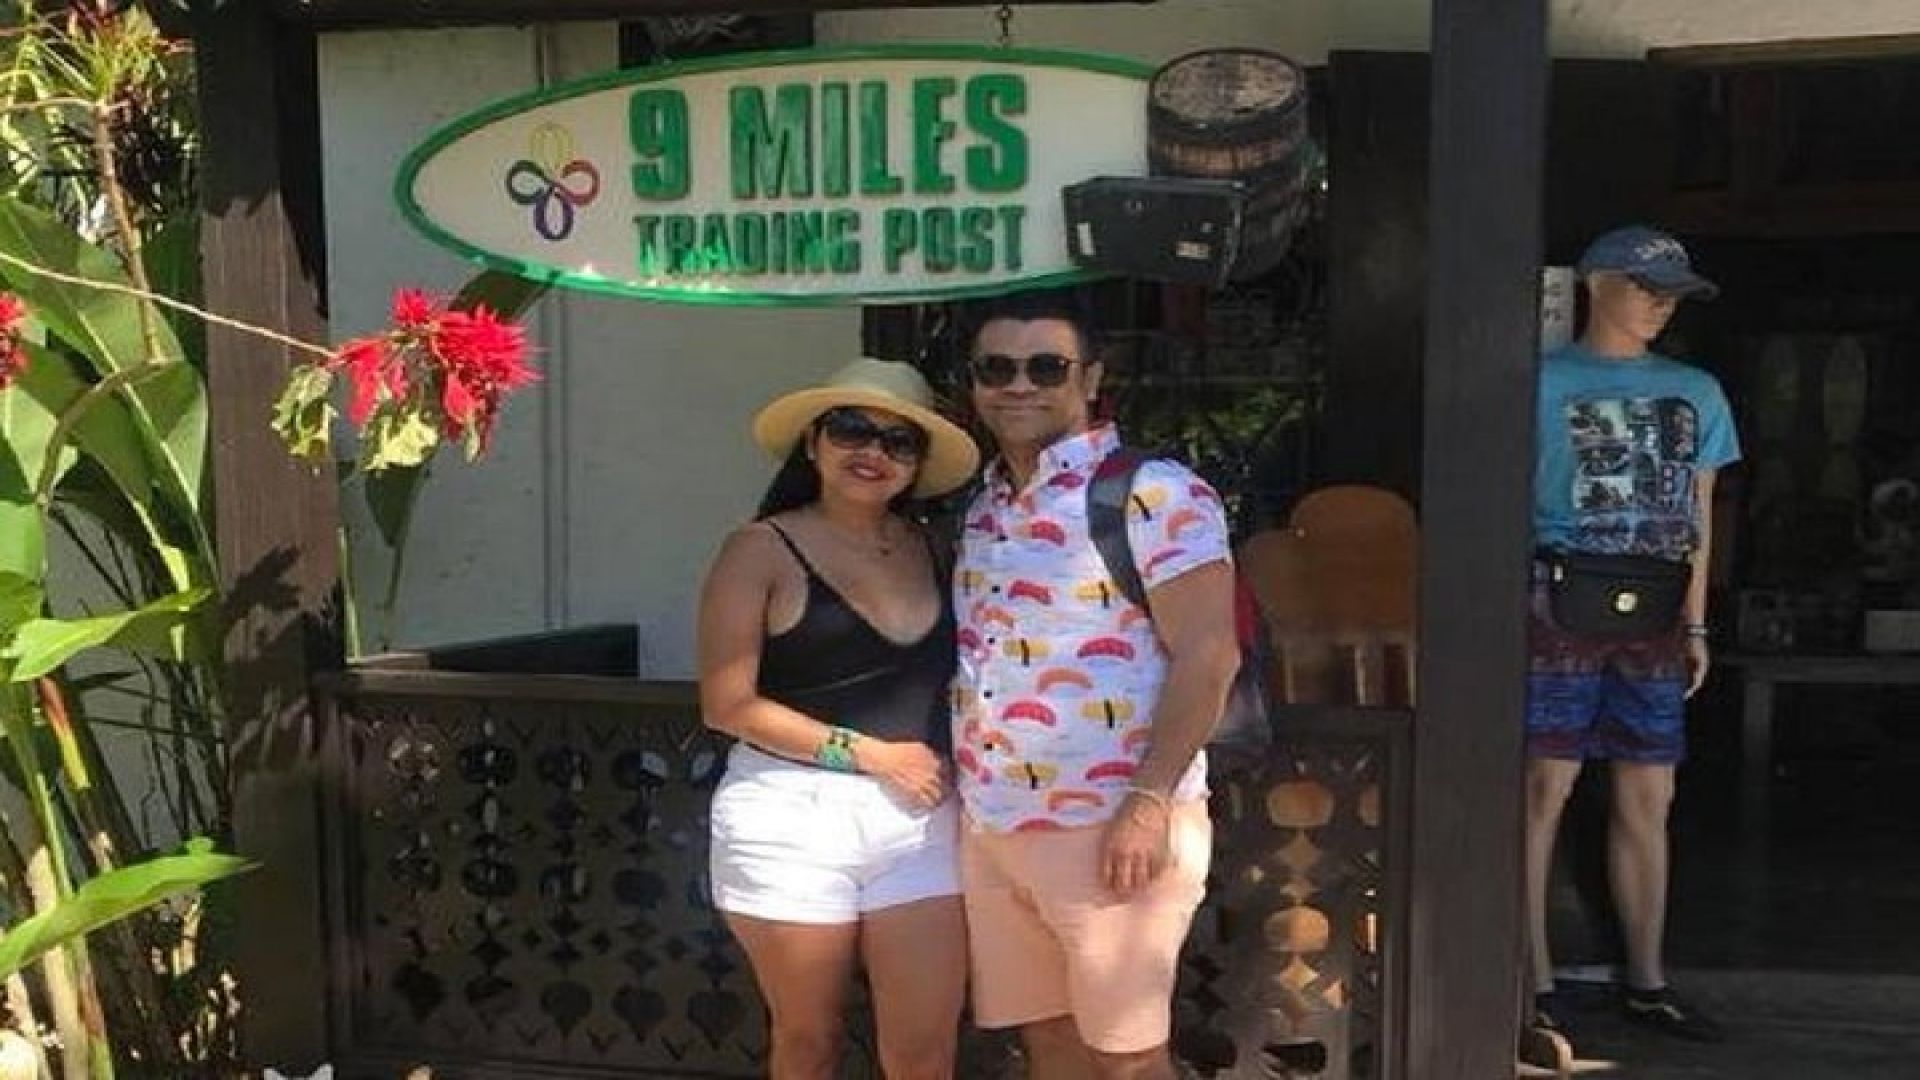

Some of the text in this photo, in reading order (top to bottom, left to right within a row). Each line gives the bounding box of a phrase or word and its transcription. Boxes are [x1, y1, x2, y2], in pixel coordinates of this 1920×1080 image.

[630, 73, 1028, 201] 9 MILES
[633, 205, 1025, 276] TRADING POST
